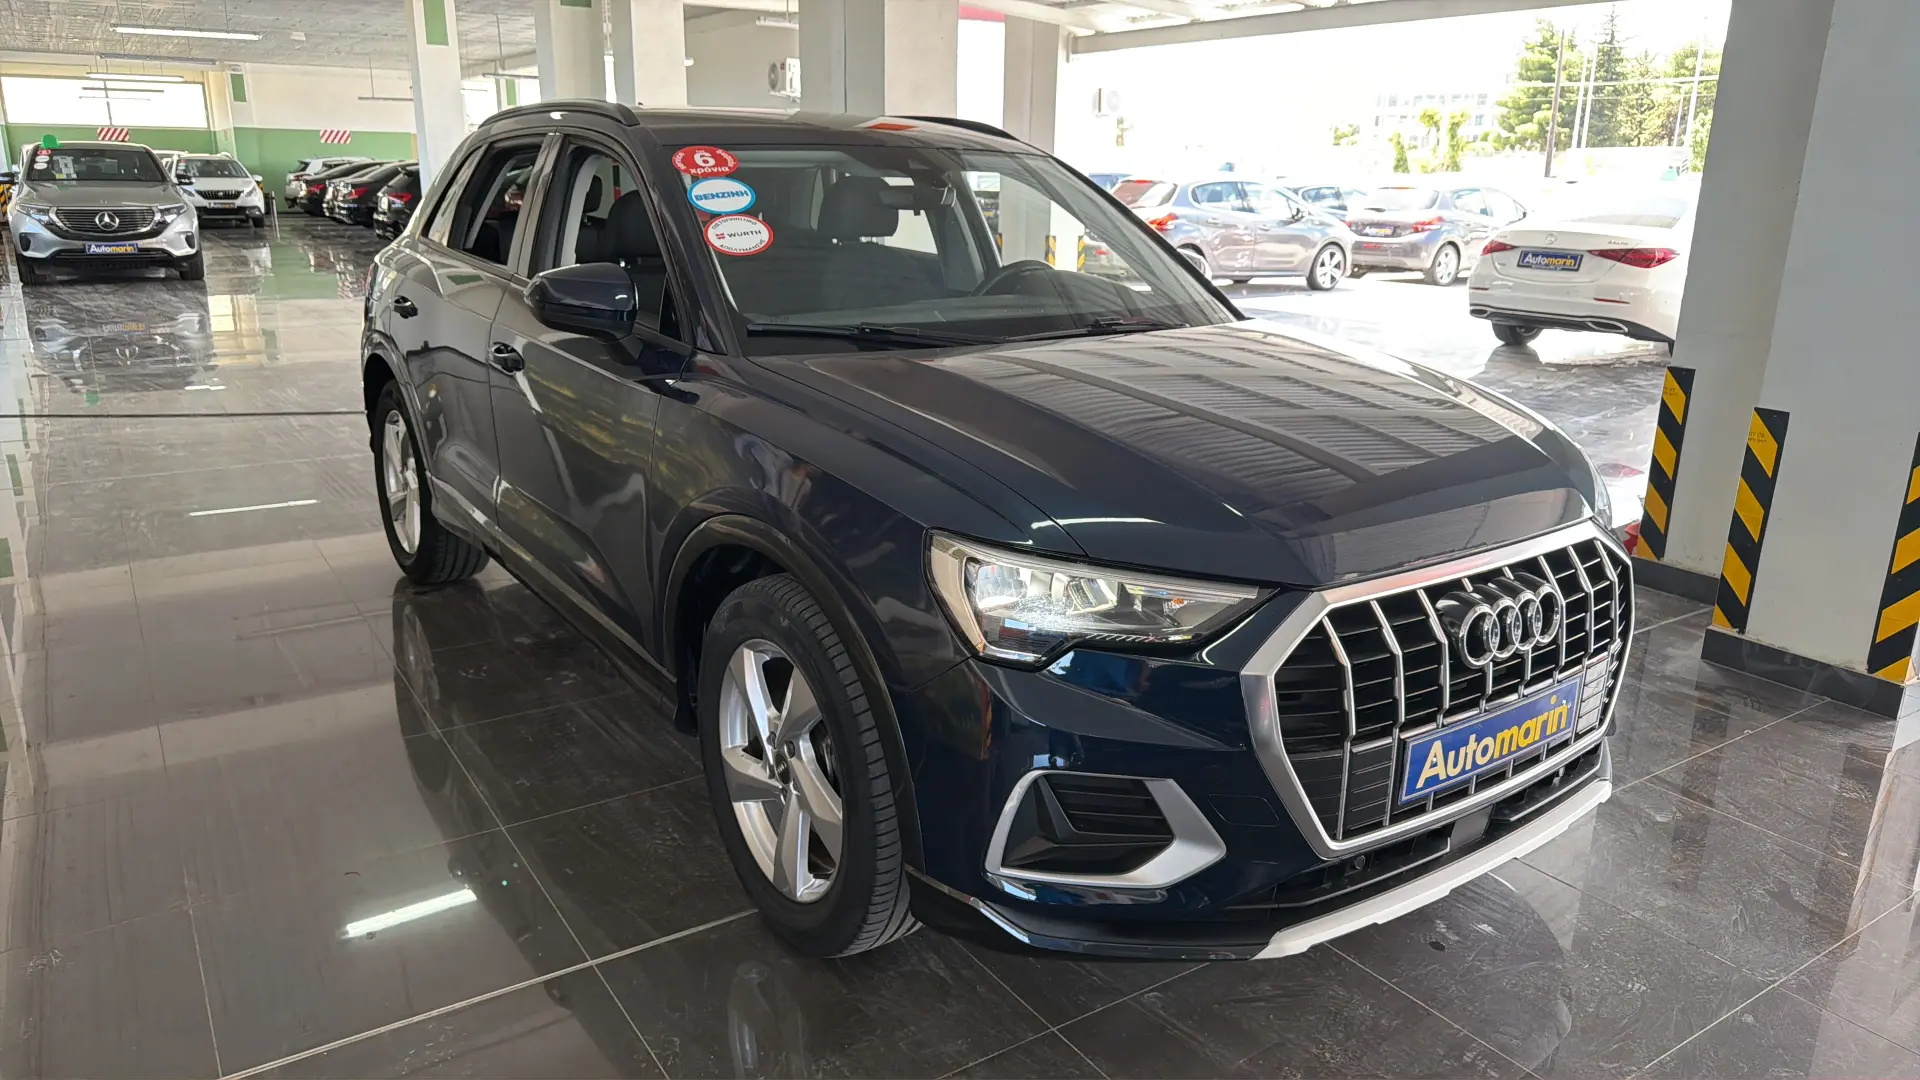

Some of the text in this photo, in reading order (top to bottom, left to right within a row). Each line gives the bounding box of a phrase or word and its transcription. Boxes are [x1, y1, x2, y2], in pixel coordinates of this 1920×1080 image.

[694, 151, 715, 167] 6
[690, 166, 730, 174] χρόνια
[90, 243, 134, 253] Automarin
[1524, 253, 1575, 267] Automarin
[1416, 695, 1568, 789] Automarin
